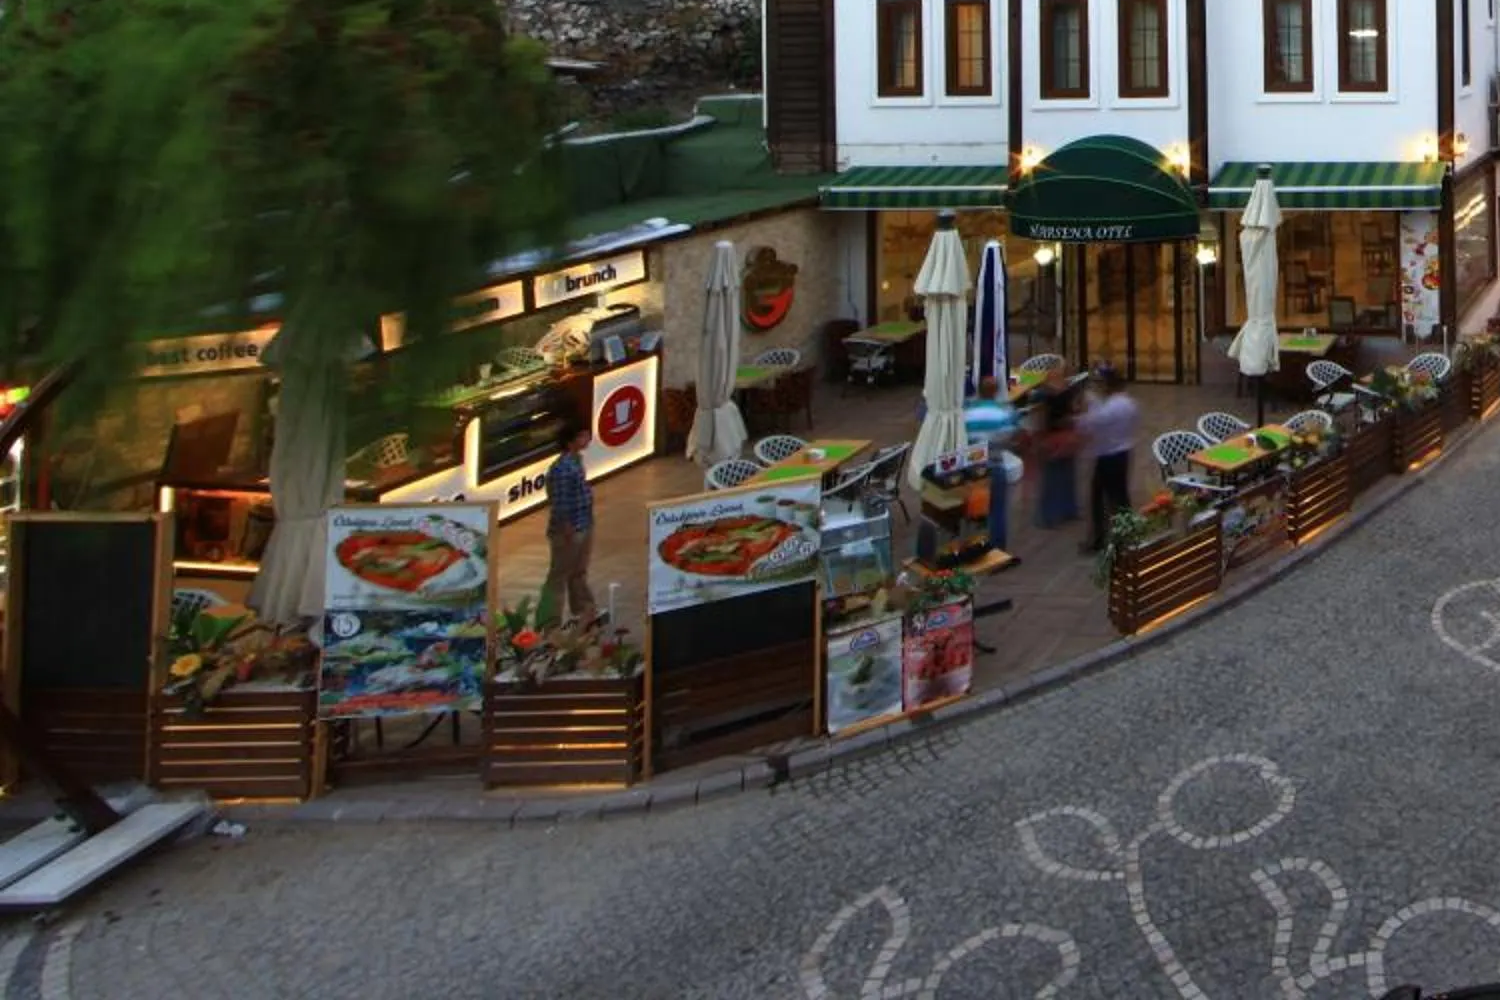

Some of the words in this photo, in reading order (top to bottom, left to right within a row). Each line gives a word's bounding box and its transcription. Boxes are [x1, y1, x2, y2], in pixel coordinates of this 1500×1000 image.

[565, 264, 616, 292] brunch
[197, 341, 257, 361] coffee
[507, 473, 546, 502] sho
